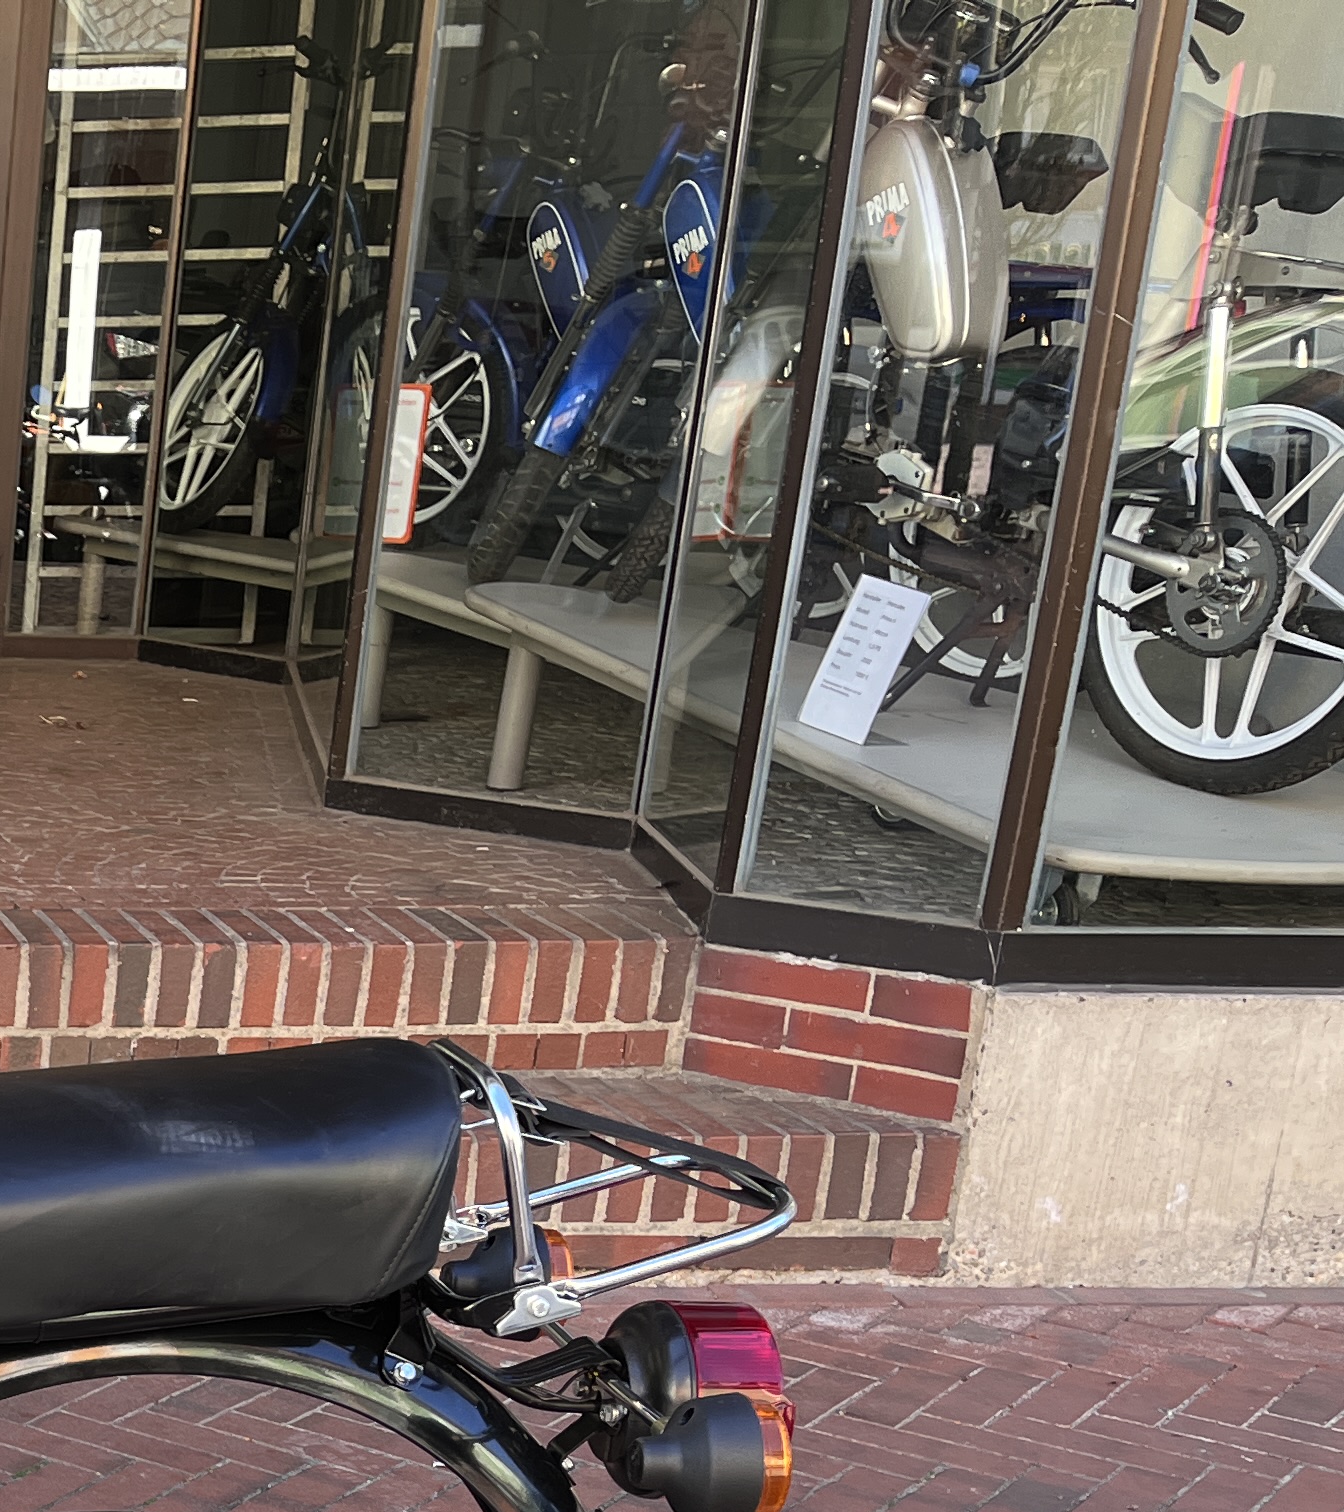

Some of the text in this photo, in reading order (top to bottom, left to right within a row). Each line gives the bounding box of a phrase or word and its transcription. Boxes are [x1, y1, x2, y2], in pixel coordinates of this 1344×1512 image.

[866, 182, 910, 226] PRIMA
[883, 212, 901, 239] 4
[531, 227, 562, 260] PRIMA
[673, 226, 709, 265] PRIMA
[687, 252, 703, 274] 4
